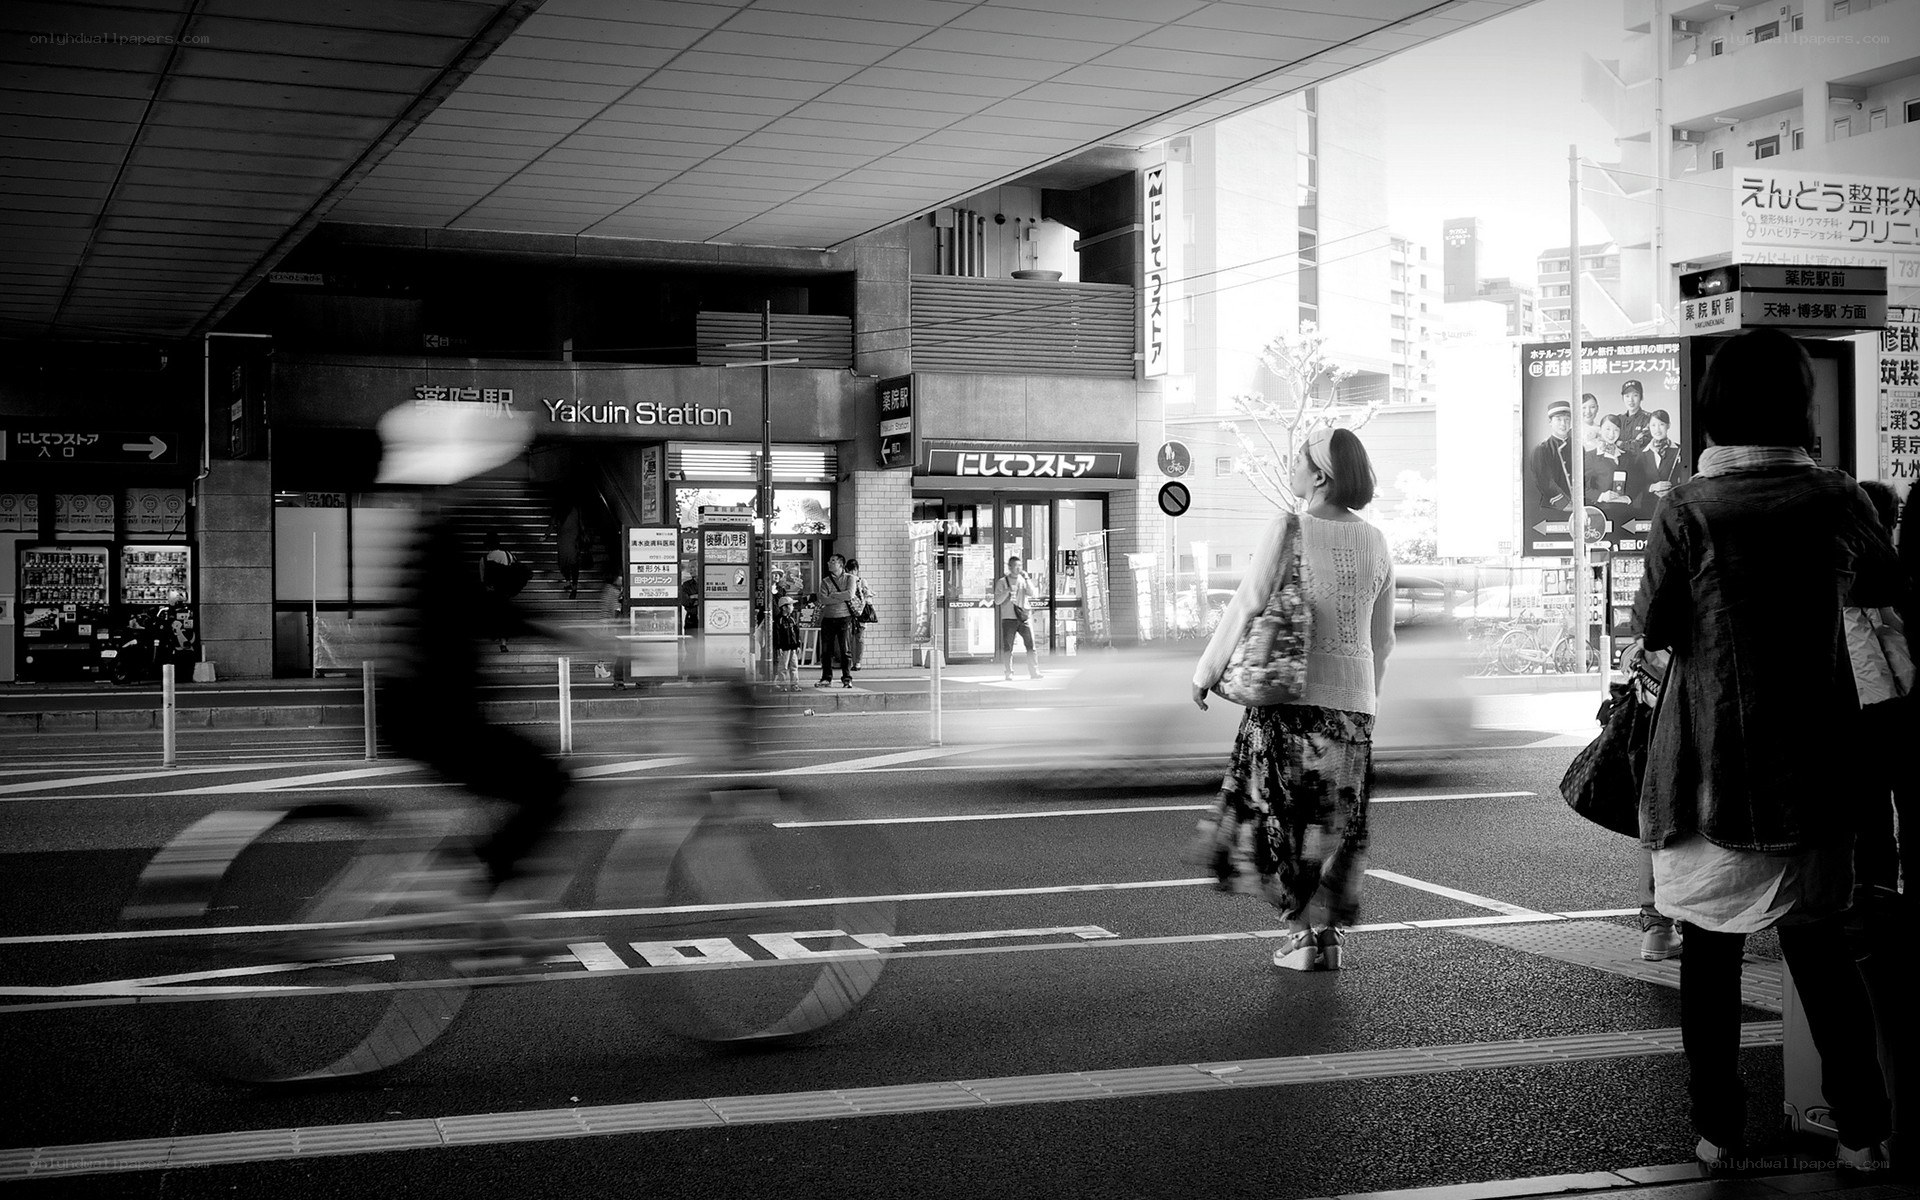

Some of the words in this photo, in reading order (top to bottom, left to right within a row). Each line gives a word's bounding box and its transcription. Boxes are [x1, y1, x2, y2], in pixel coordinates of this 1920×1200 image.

[1760, 227, 1842, 241] リハビリテーション科
[1149, 200, 1162, 364] にしてつストア
[1785, 270, 1845, 287] 薬院駅前
[1685, 297, 1734, 321] 薬院駅前
[1764, 302, 1837, 319] 天神・博多駅
[1841, 304, 1867, 319] 方面
[1879, 358, 1918, 386] 筑紫
[882, 387, 908, 411] 薬院駅
[543, 398, 629, 424] Yakuin
[636, 402, 732, 426] Station
[17, 432, 99, 446] にしてつストア
[38, 446, 75, 458] 入口
[956, 453, 1096, 478] にしてつストア
[706, 532, 747, 547] 後藤小児科
[637, 565, 670, 573] 整形外科
[634, 576, 673, 584] 田中クリニック
